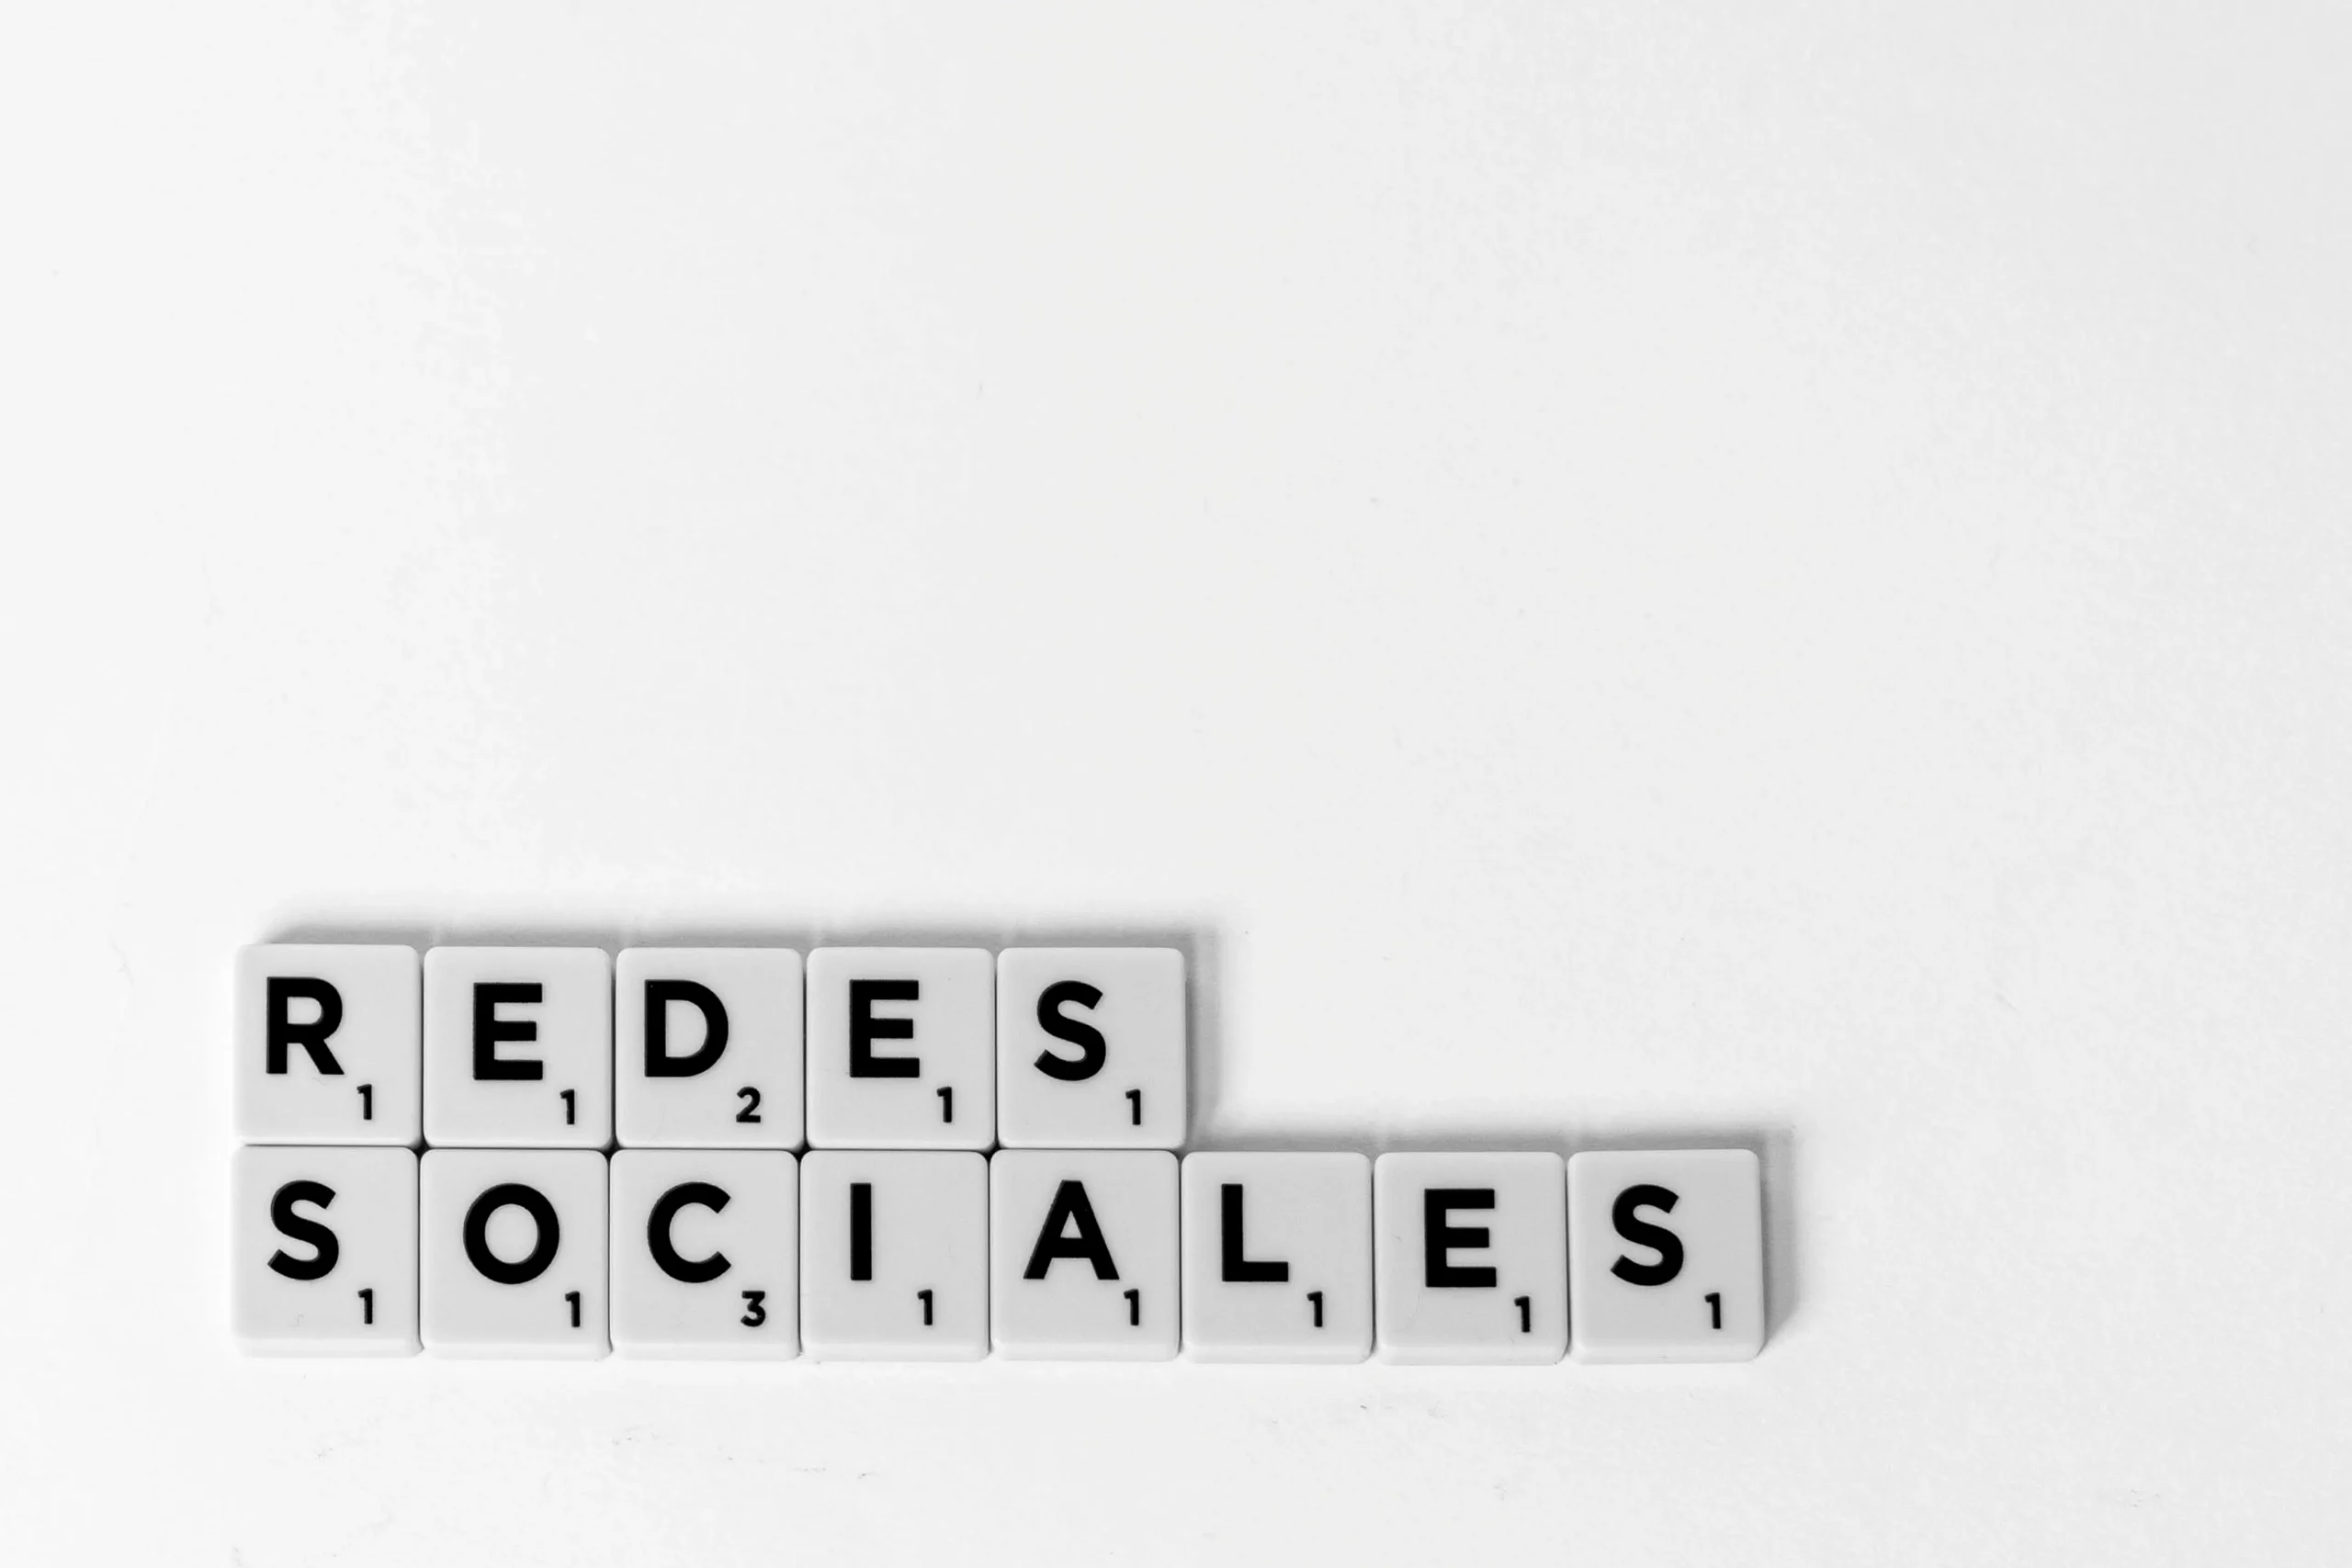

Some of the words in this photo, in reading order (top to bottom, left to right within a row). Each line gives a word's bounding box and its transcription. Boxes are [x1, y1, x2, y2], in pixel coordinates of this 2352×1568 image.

[266, 976, 1107, 1082] REDES
[357, 1084, 373, 1121] 1
[560, 1089, 575, 1125] 1
[736, 1086, 762, 1123] 2
[937, 1086, 953, 1123] 1
[1125, 1089, 1142, 1126] 1
[267, 1179, 1685, 1289] SOCIALES
[358, 1288, 374, 1325] 1
[565, 1291, 581, 1328] 1
[741, 1290, 766, 1328] 3
[917, 1289, 933, 1326] 1
[1123, 1288, 1140, 1326] 1
[1307, 1291, 1324, 1328] 1
[1514, 1295, 1532, 1334] 1
[1704, 1292, 1722, 1330] 1
